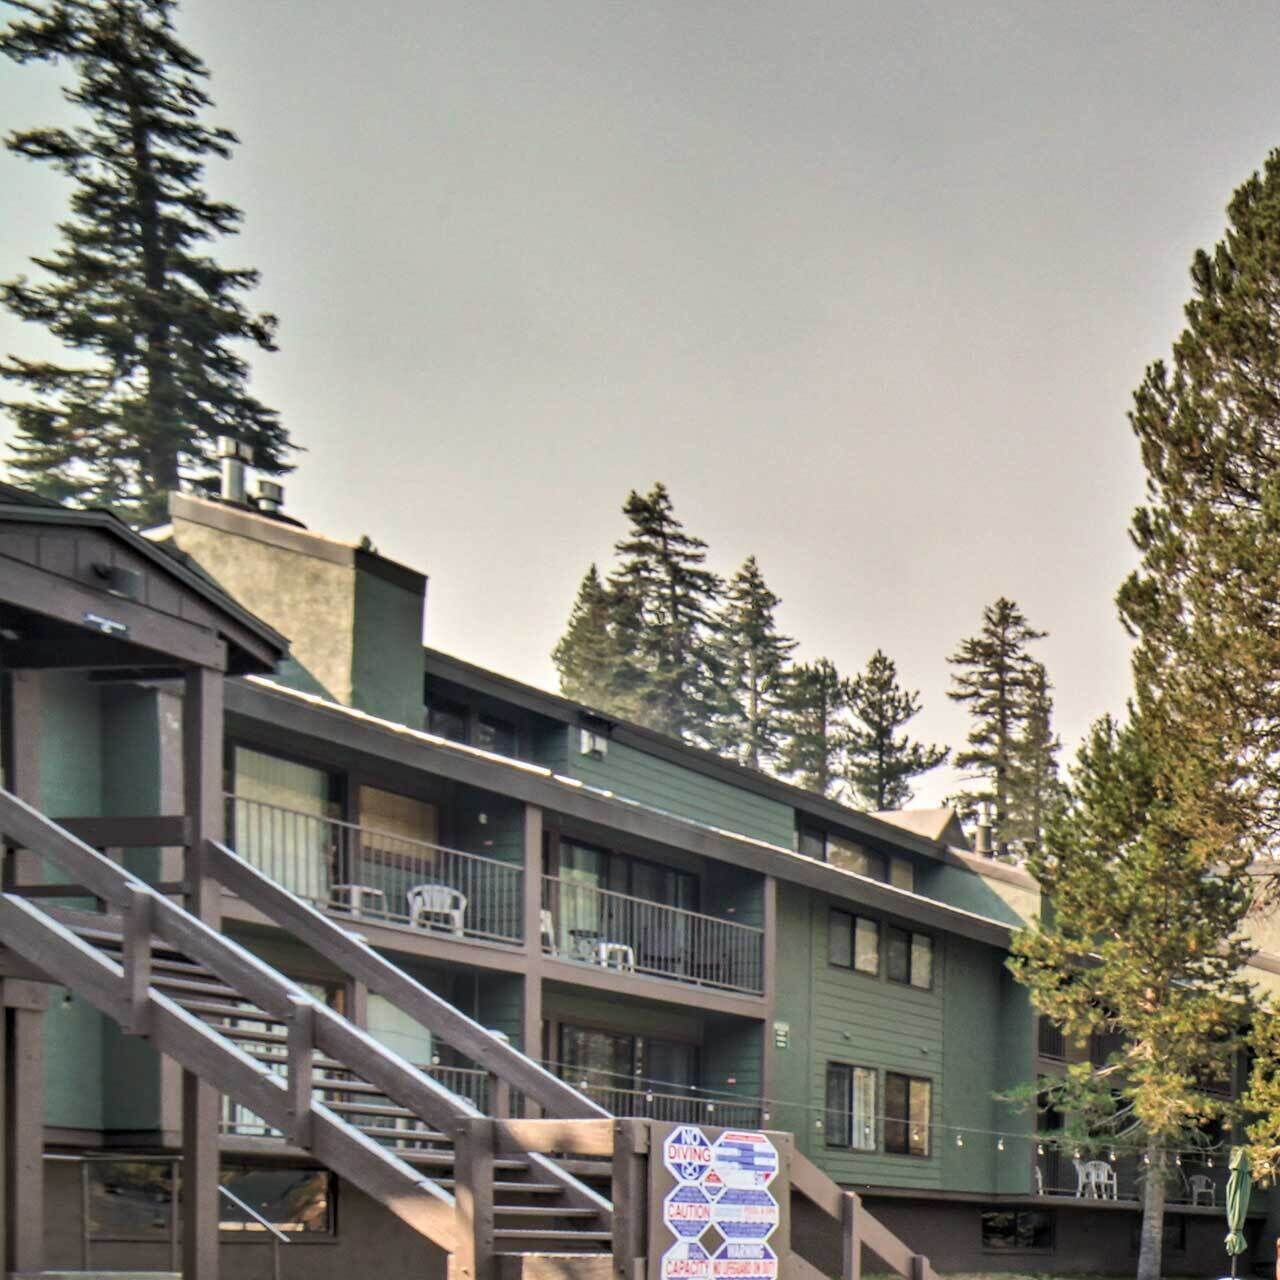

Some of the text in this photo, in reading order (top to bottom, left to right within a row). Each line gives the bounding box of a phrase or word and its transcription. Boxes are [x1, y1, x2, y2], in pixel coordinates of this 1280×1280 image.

[682, 1129, 701, 1145] NO
[669, 1145, 711, 1162] DIVING
[669, 1204, 710, 1219] CAUTION
[727, 1244, 764, 1259] WARNING
[667, 1261, 710, 1275] CAPACITY
